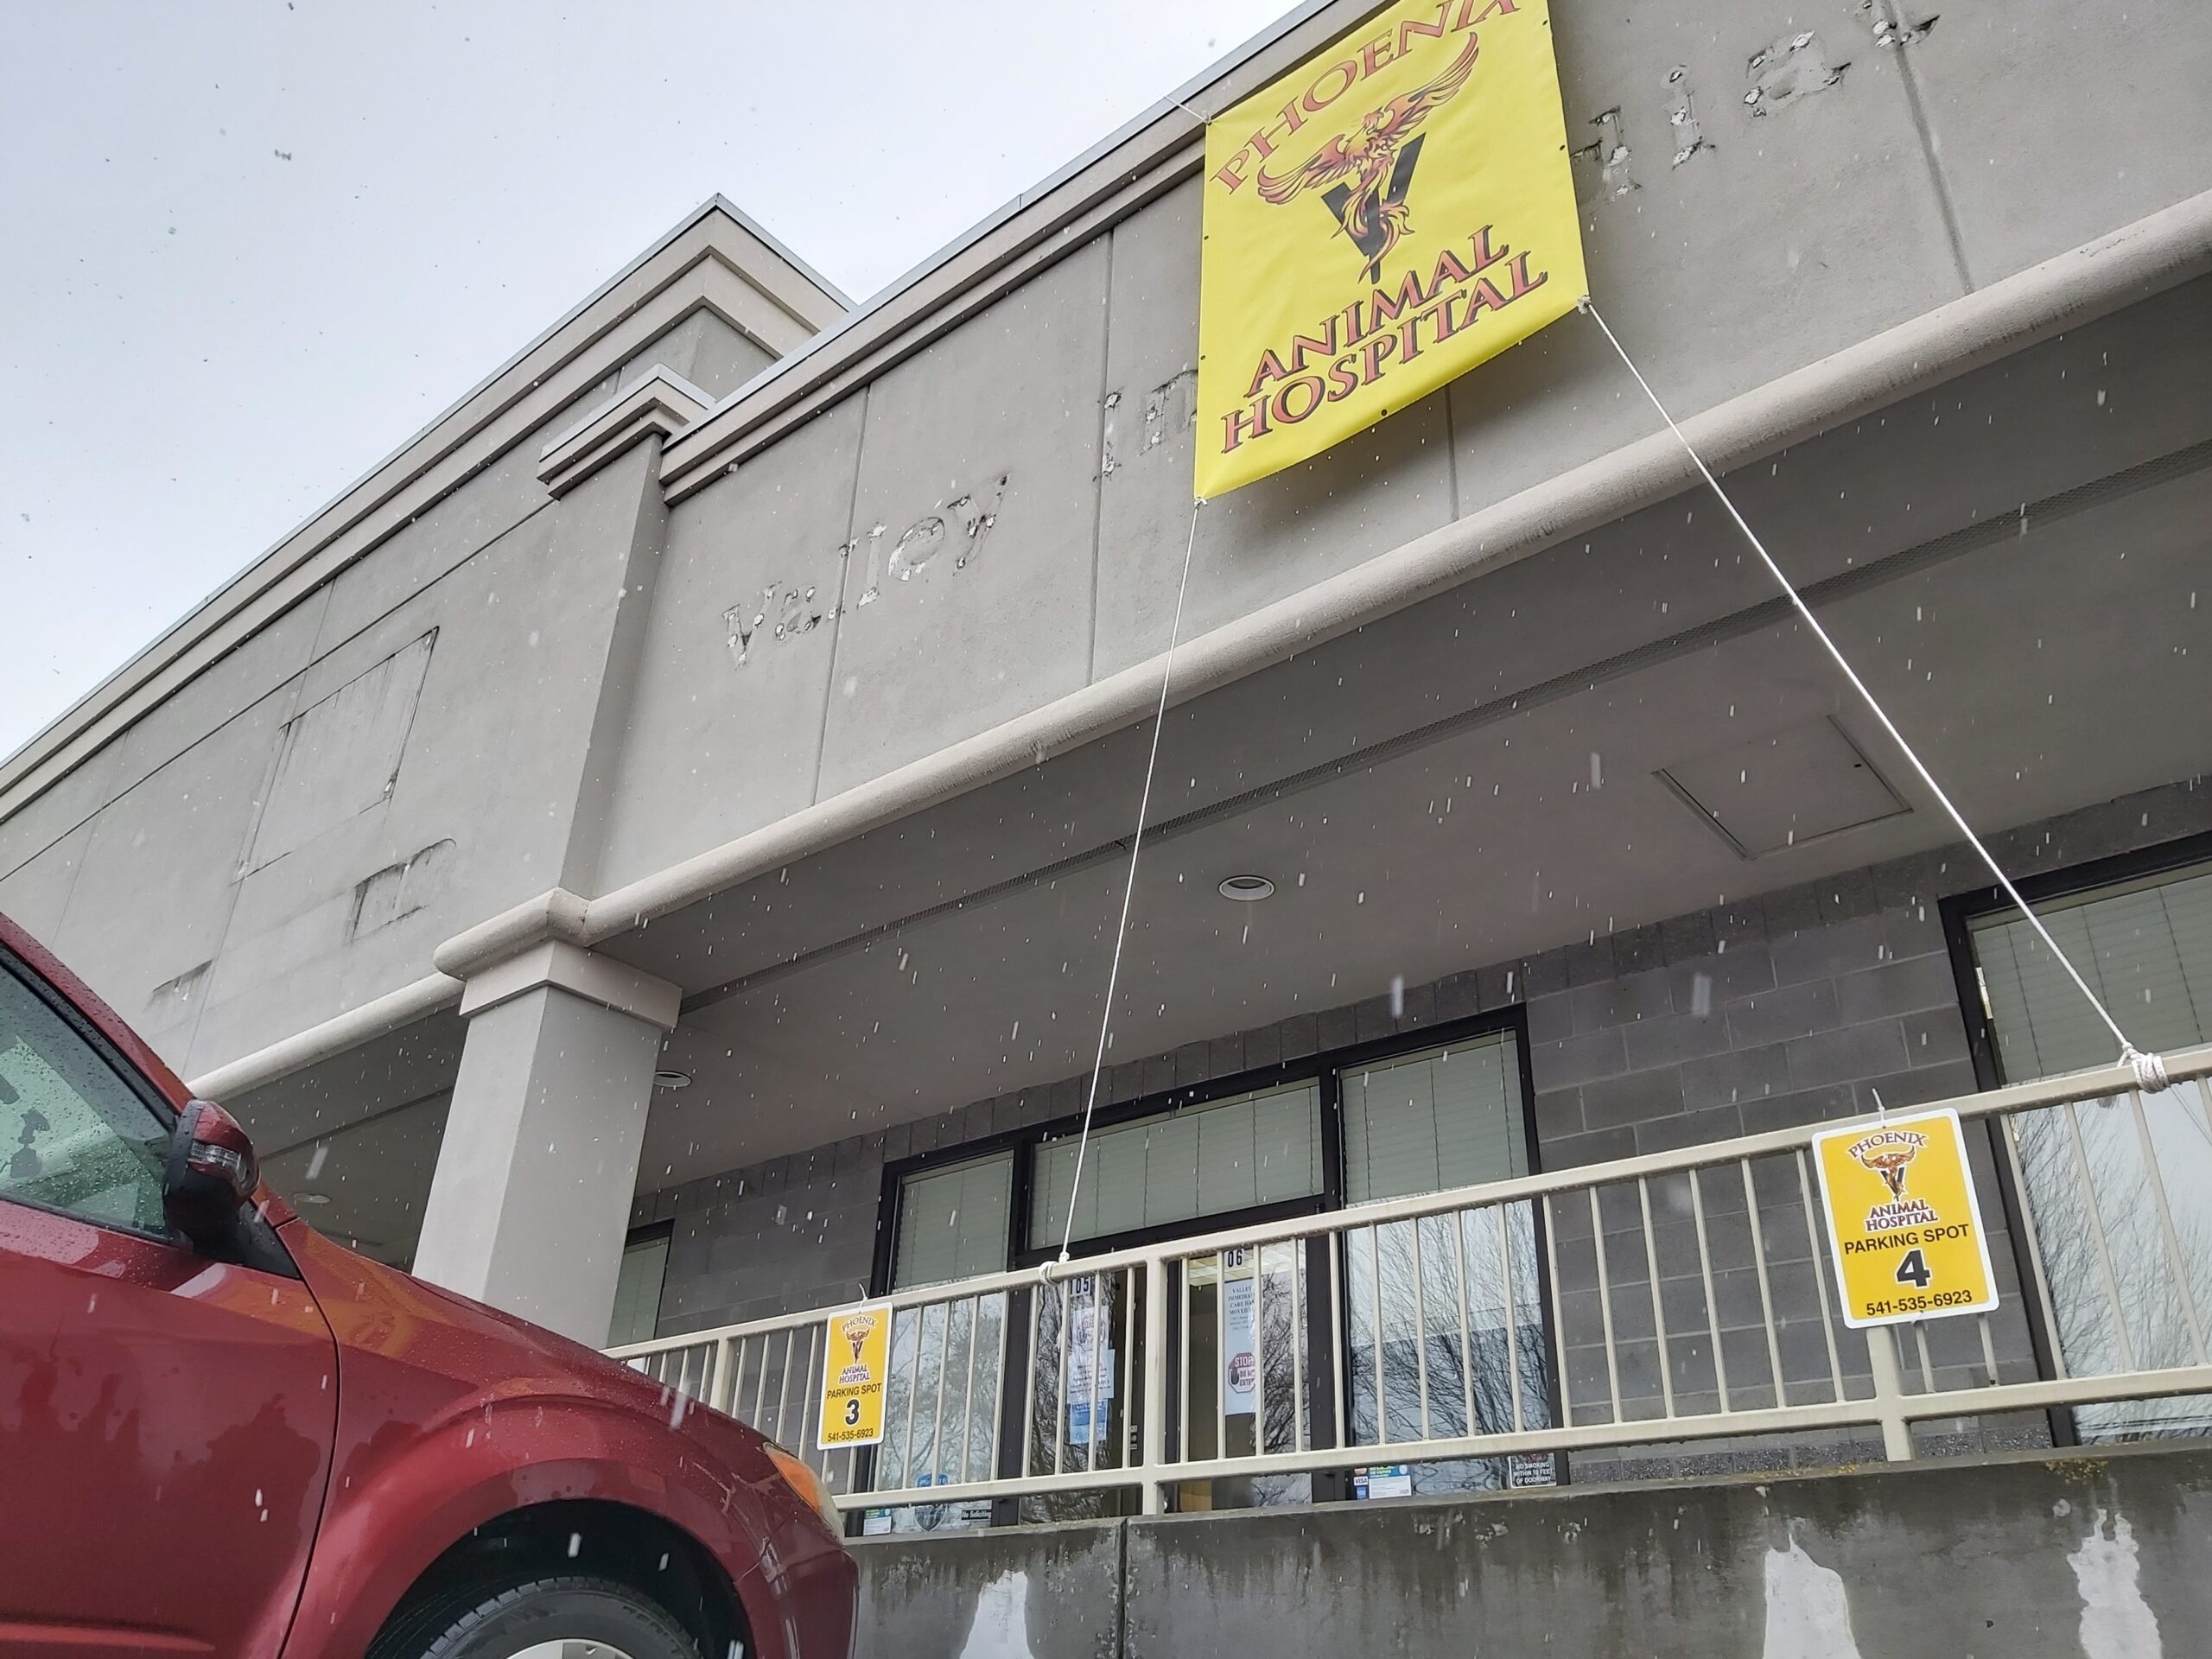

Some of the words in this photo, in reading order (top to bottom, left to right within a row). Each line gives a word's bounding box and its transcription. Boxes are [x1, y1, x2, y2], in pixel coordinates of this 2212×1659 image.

[1243, 225, 1510, 399] ANIMAL
[1220, 251, 1548, 454] HOSPITAL
[1847, 1132, 1928, 1158] PHOENIX
[1870, 1199, 1929, 1218] ANIMAL
[1865, 1211, 1938, 1231] HOSPITAL
[1844, 1232, 1919, 1255] PARKING
[1923, 1224, 1969, 1243] SPOT
[1896, 1249, 1931, 1287] 4
[1866, 1290, 1972, 1316] 541-535-6923
[842, 1316, 876, 1332] PHOENIX
[842, 1364, 868, 1375] ANIMAL
[1235, 1356, 1253, 1367] STOP
[839, 1372, 870, 1383] HOSPITAL
[827, 1386, 860, 1399] PARKING
[861, 1382, 882, 1394] SPOT
[845, 1399, 860, 1425] 3
[828, 1428, 874, 1442] 541-535-6923
